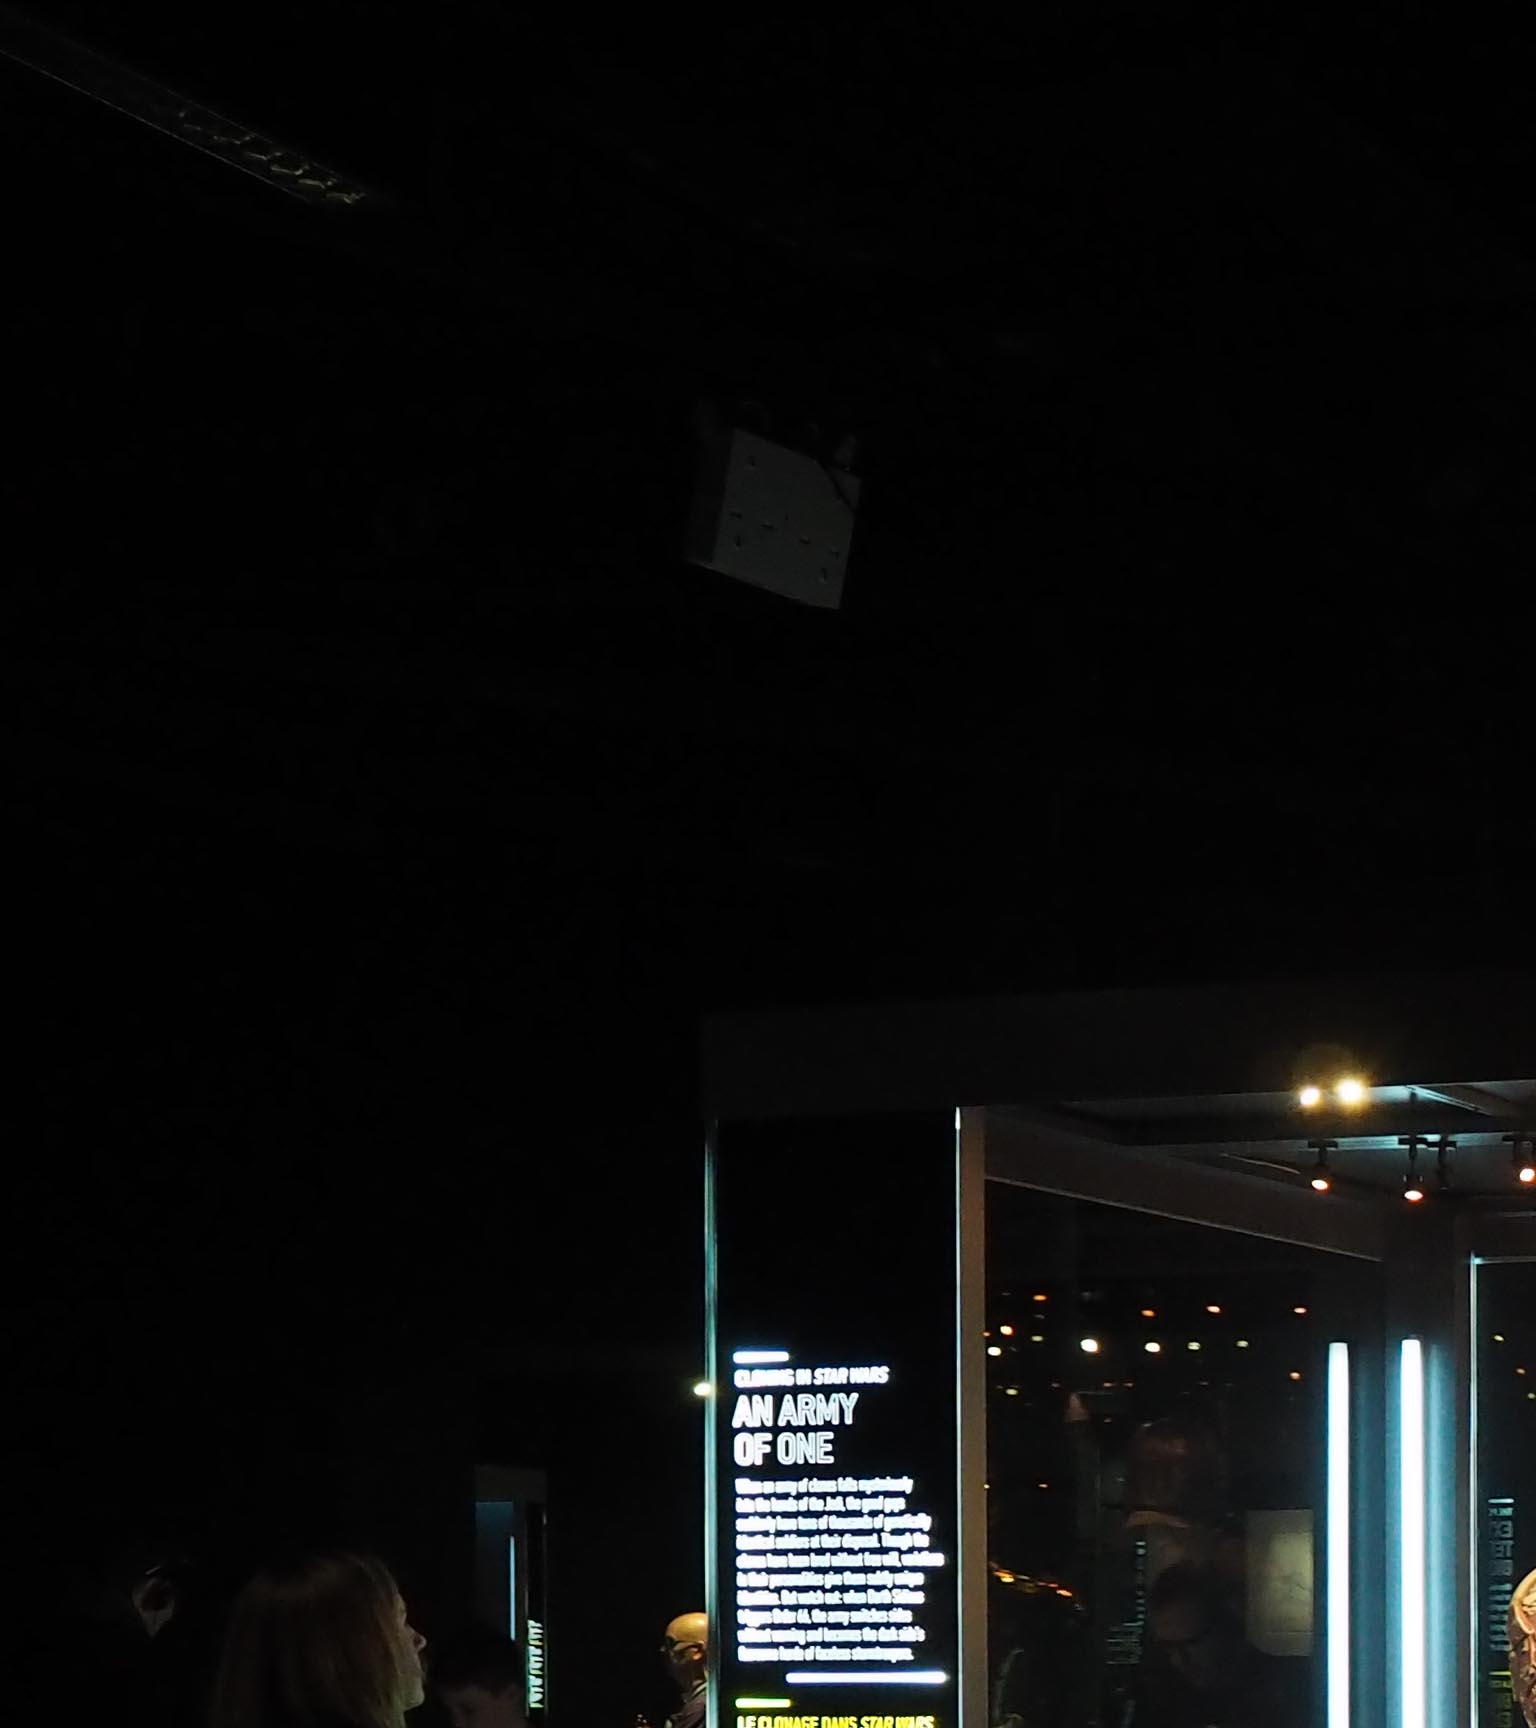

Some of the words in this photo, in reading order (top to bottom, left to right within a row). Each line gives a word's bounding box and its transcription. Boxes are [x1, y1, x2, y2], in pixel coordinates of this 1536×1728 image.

[813, 1368, 849, 1385] STAR
[732, 1394, 773, 1428] AN
[778, 1393, 859, 1426] ARMY
[734, 1432, 773, 1466] OF
[777, 1432, 834, 1465] ONE
